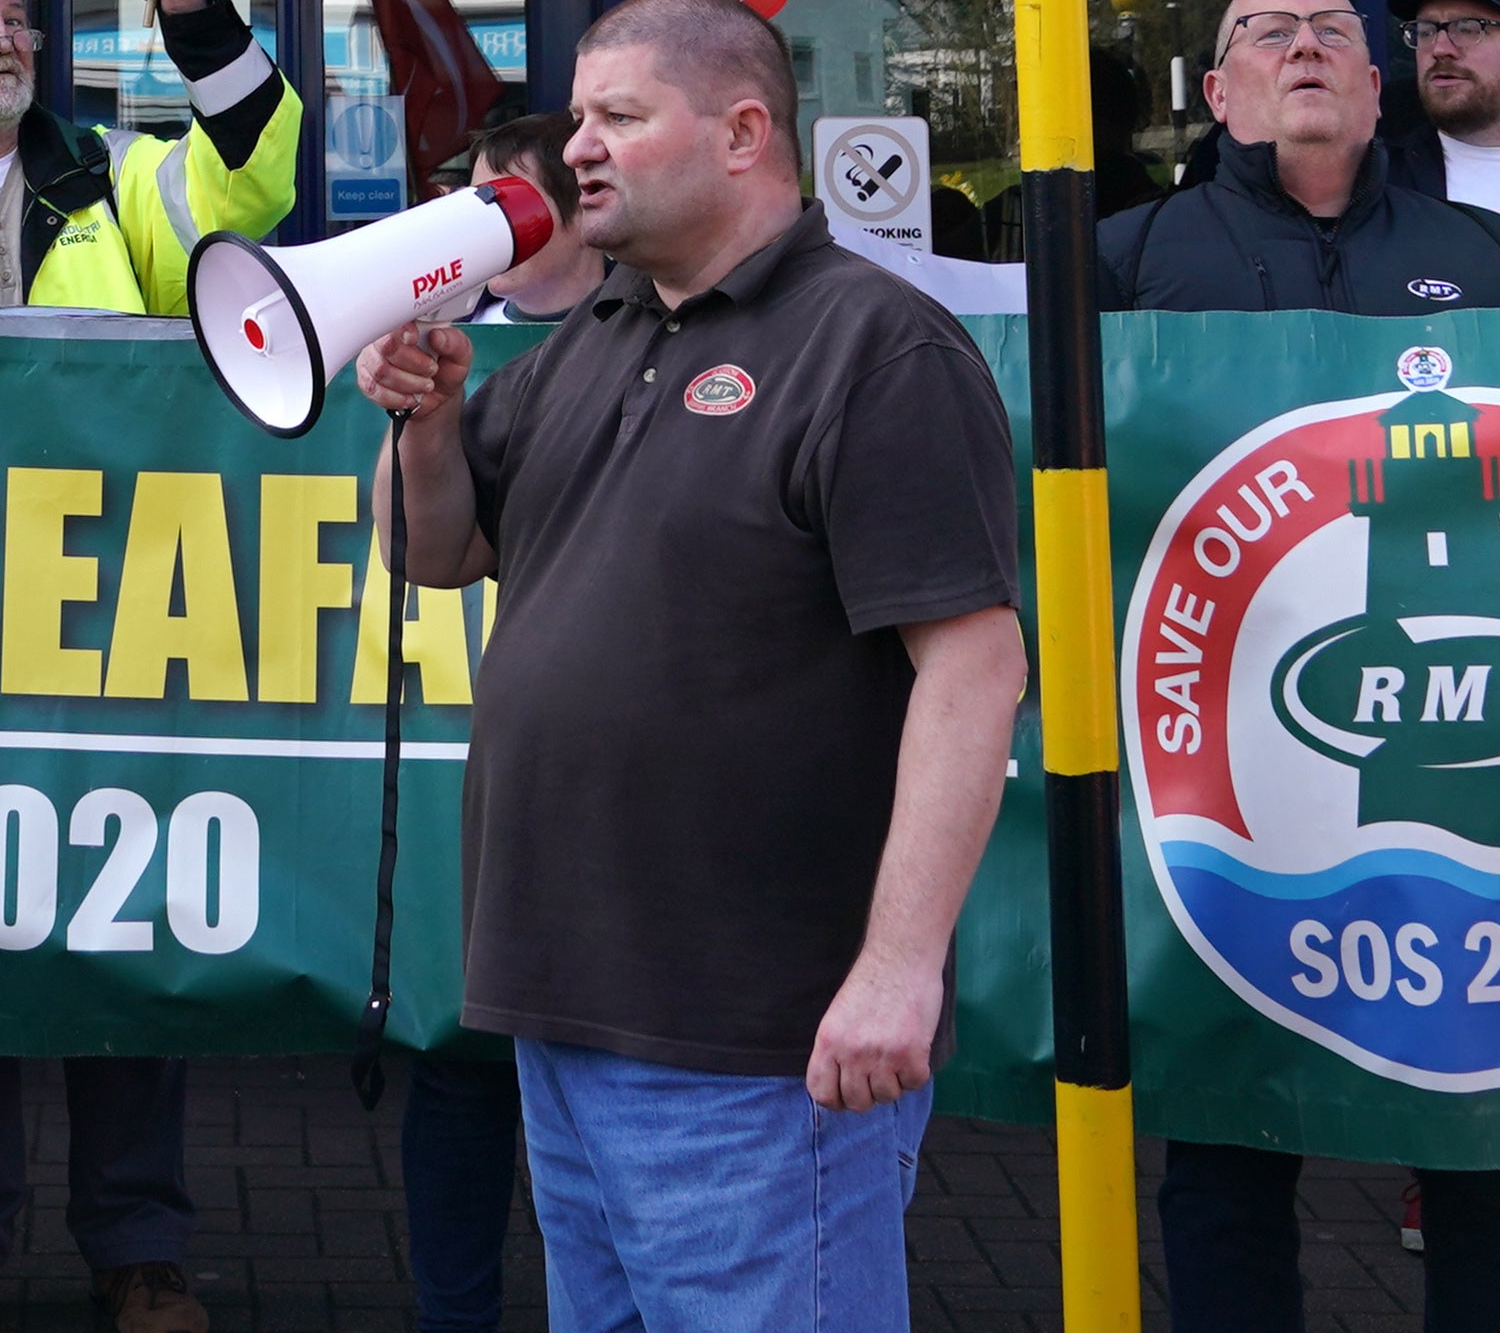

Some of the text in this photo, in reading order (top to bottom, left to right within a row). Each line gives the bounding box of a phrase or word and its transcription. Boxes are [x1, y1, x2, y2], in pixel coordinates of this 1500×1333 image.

[338, 190, 396, 202] Keep clear
[863, 228, 922, 239] OKING
[412, 259, 462, 299] PYLE
[1419, 283, 1452, 295] RMT
[1154, 584, 1215, 755] SAVE
[1193, 458, 1315, 578] OUR
[1289, 918, 1443, 1007] SOS
